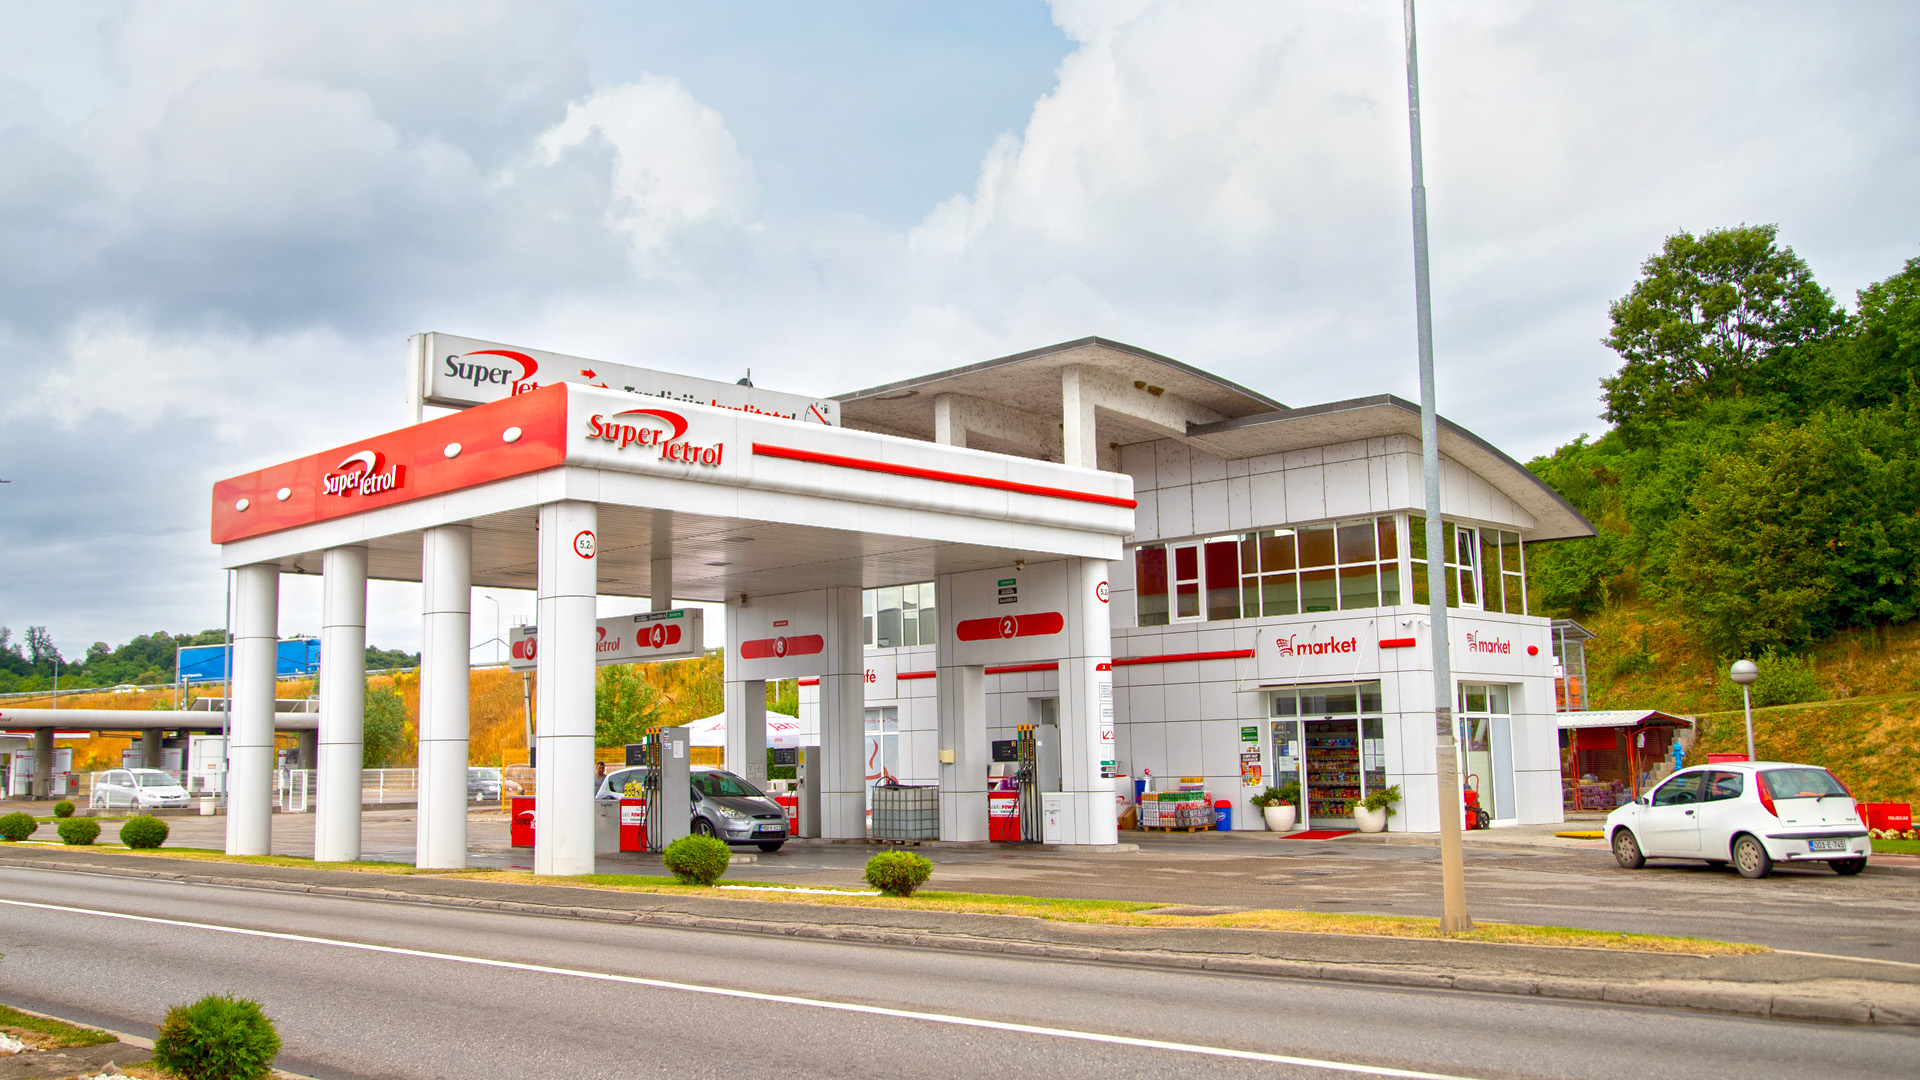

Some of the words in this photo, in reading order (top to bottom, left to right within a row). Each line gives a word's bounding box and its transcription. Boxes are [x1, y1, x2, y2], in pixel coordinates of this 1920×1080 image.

[444, 354, 512, 388] Super
[589, 414, 663, 449] Super
[612, 408, 723, 466] Petrol
[337, 450, 396, 496] Petrol
[322, 470, 361, 497] Super
[653, 627, 661, 643] 4
[1003, 620, 1012, 634] 2
[526, 642, 533, 656] 6
[777, 641, 784, 654] 8
[1297, 636, 1357, 656] market
[1478, 638, 1511, 656] market
